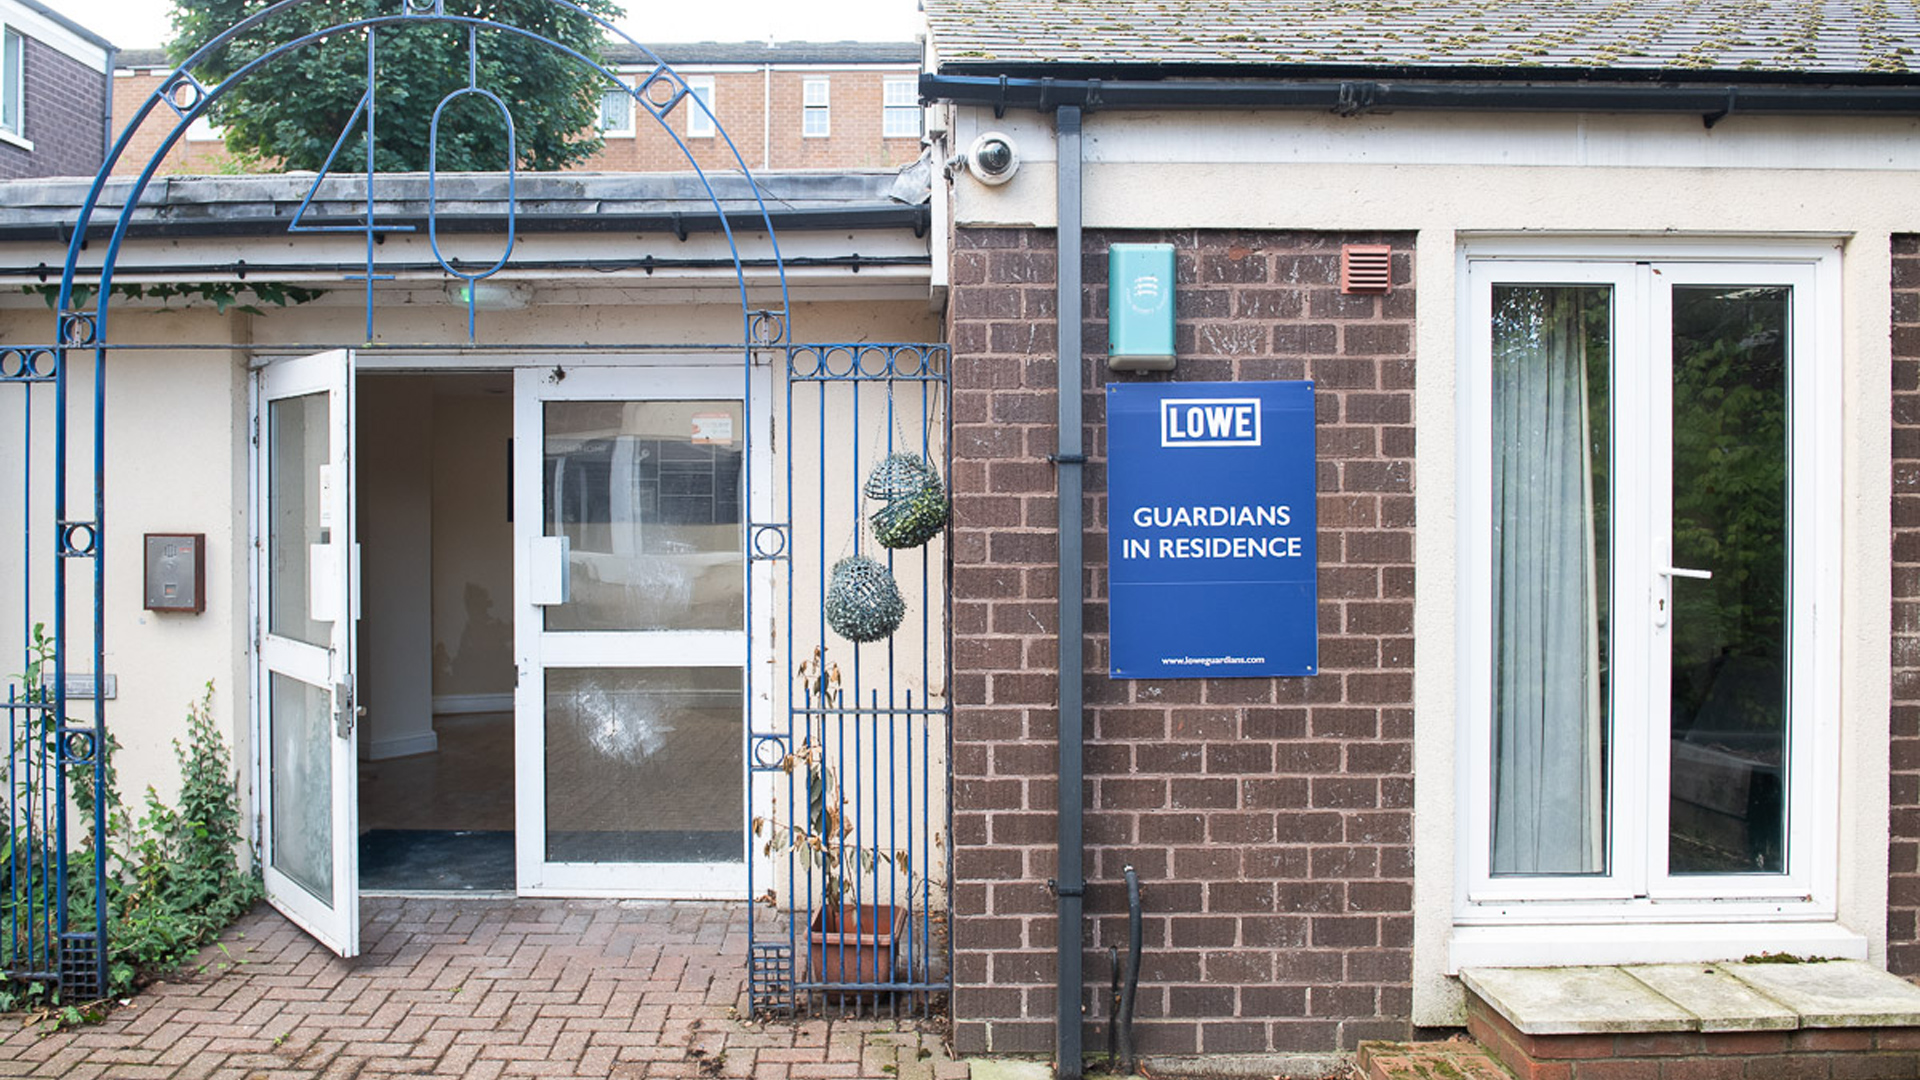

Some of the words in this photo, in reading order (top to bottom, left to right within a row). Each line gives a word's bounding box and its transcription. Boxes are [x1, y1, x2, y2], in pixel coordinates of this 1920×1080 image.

[287, 84, 516, 281] 40
[1169, 406, 1253, 439] LOWE
[1132, 505, 1291, 528] GUARDIANS
[1122, 538, 1151, 560] IN
[1158, 536, 1302, 559] RESIDENCE
[1161, 655, 1265, 667] www.loweguardians.com
